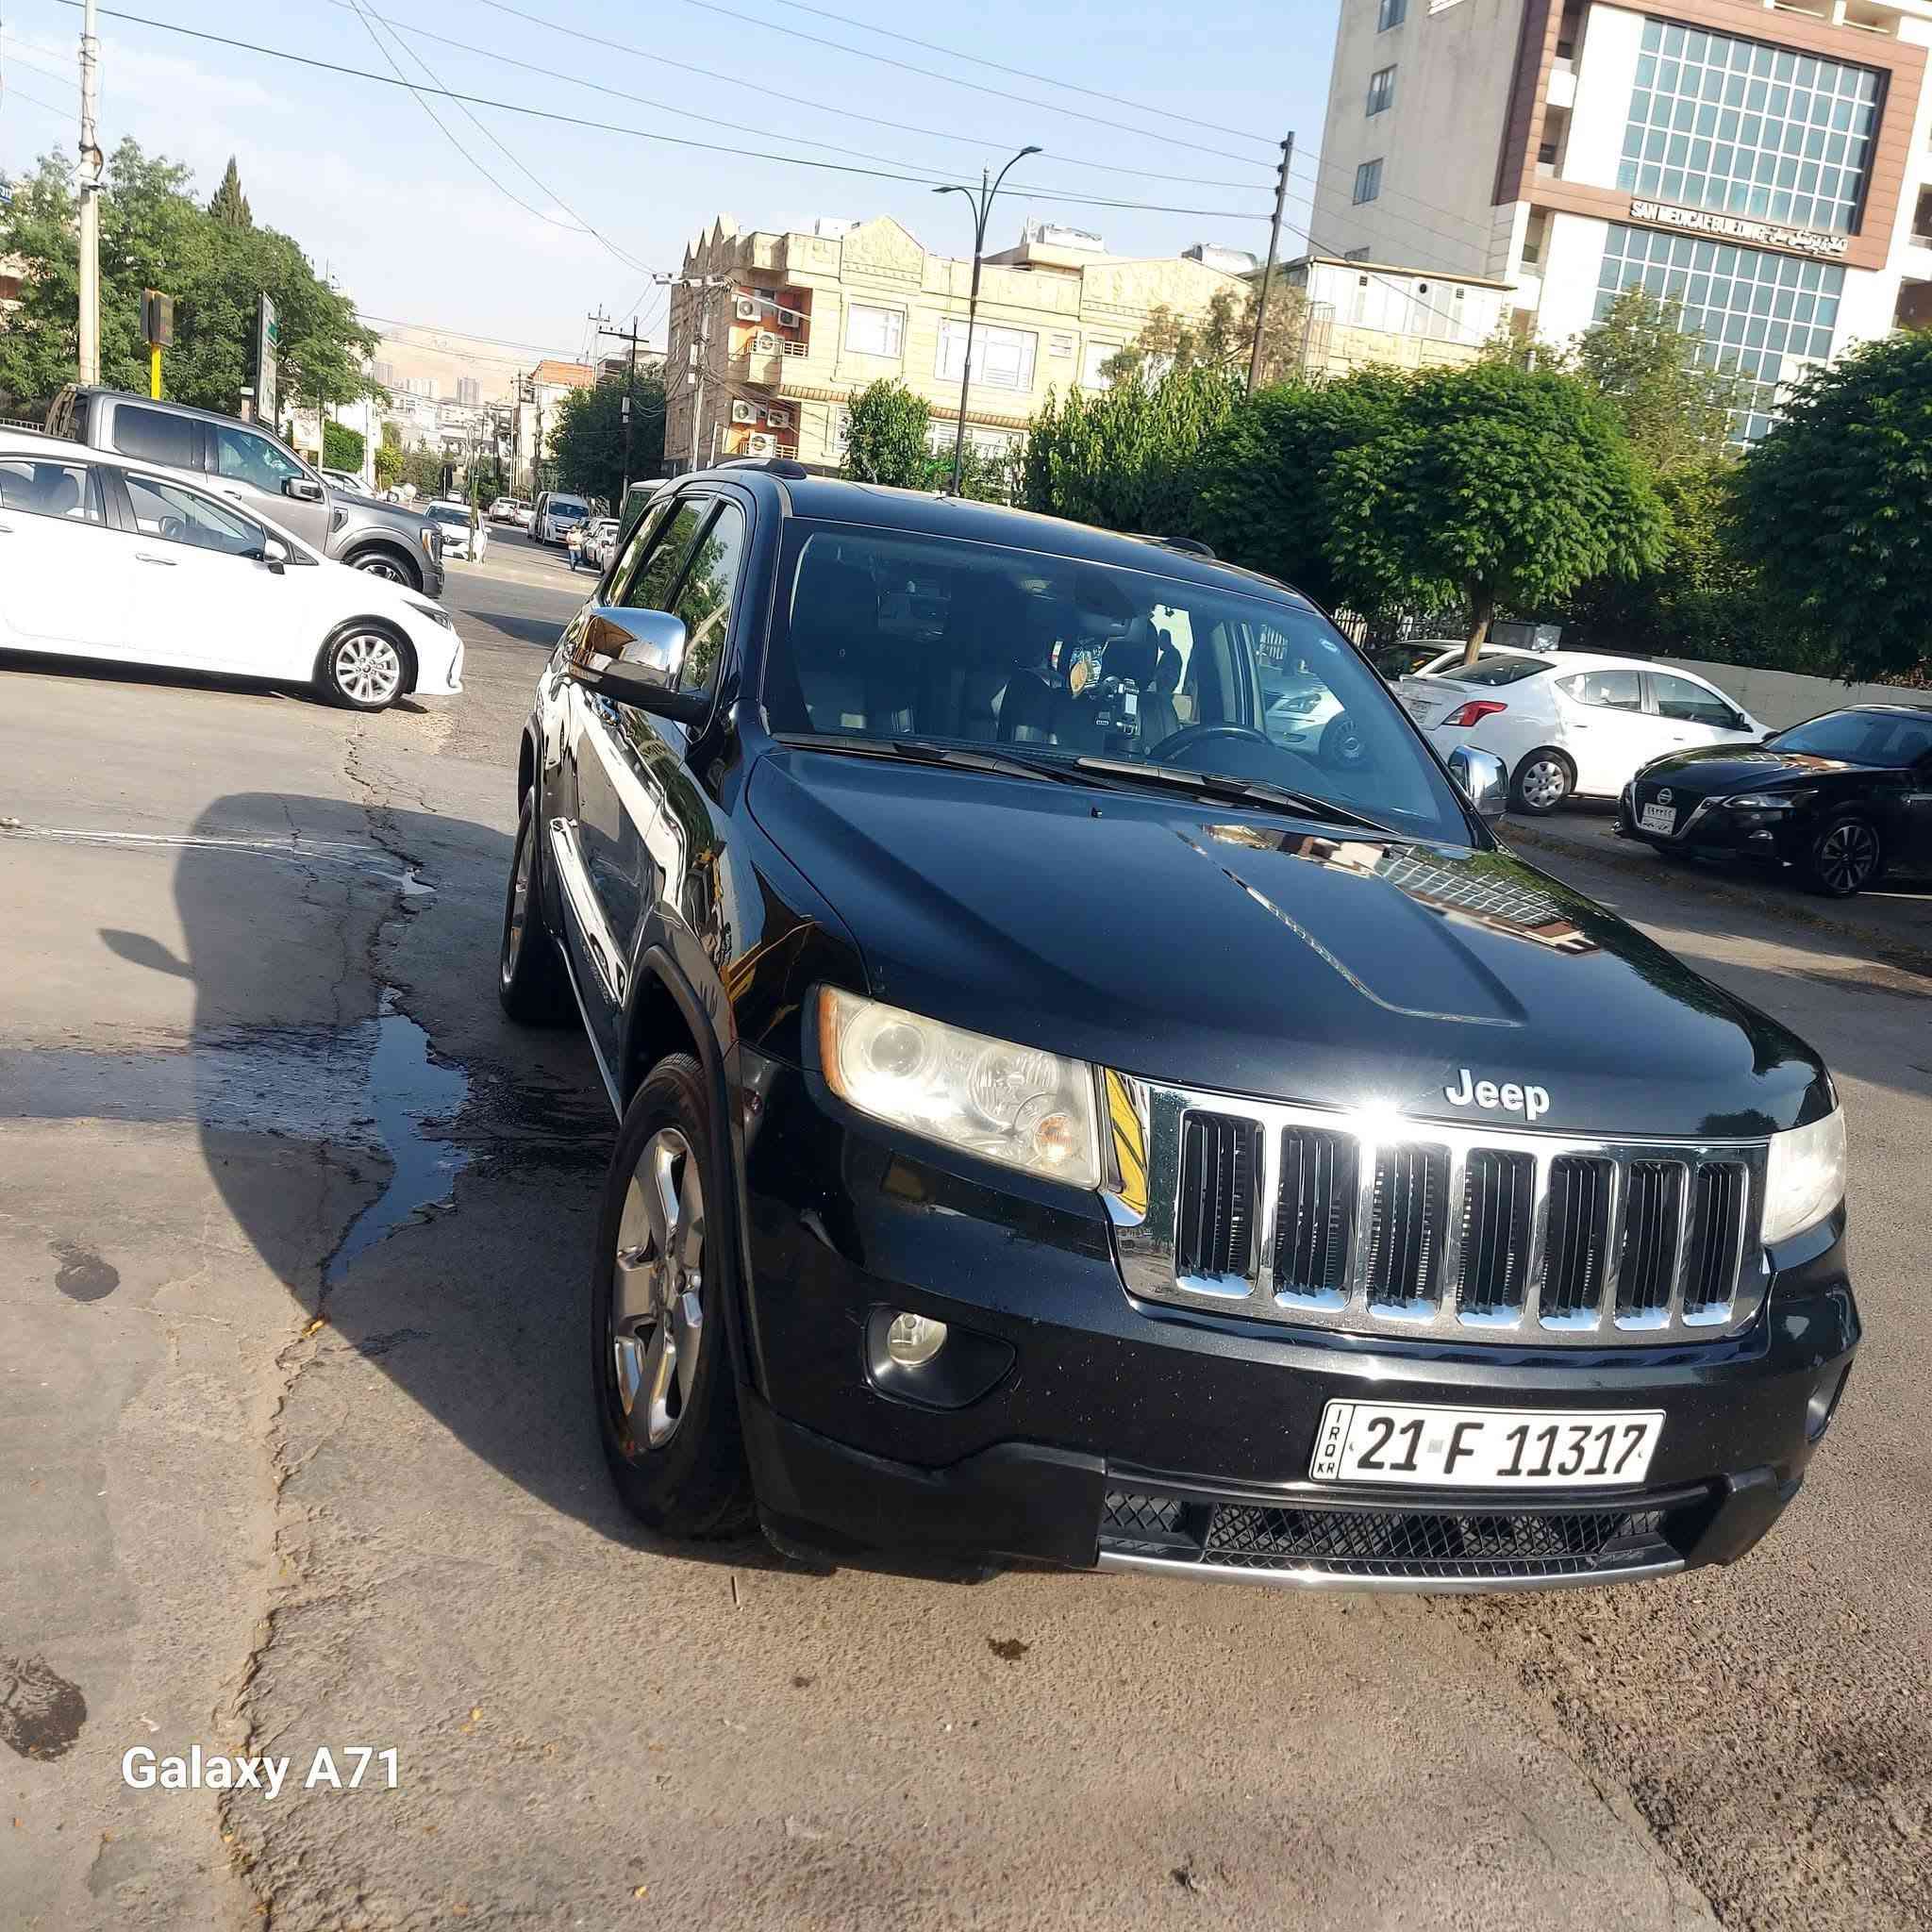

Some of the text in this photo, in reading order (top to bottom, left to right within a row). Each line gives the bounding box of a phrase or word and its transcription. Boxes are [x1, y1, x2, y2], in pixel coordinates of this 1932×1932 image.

[1630, 200, 1657, 219] SAN
[1443, 1068, 1551, 1121] Jeep
[1324, 1408, 1342, 1457] IRQ
[1356, 1416, 1648, 1476] 21 F 11317
[1316, 1462, 1336, 1474] KR
